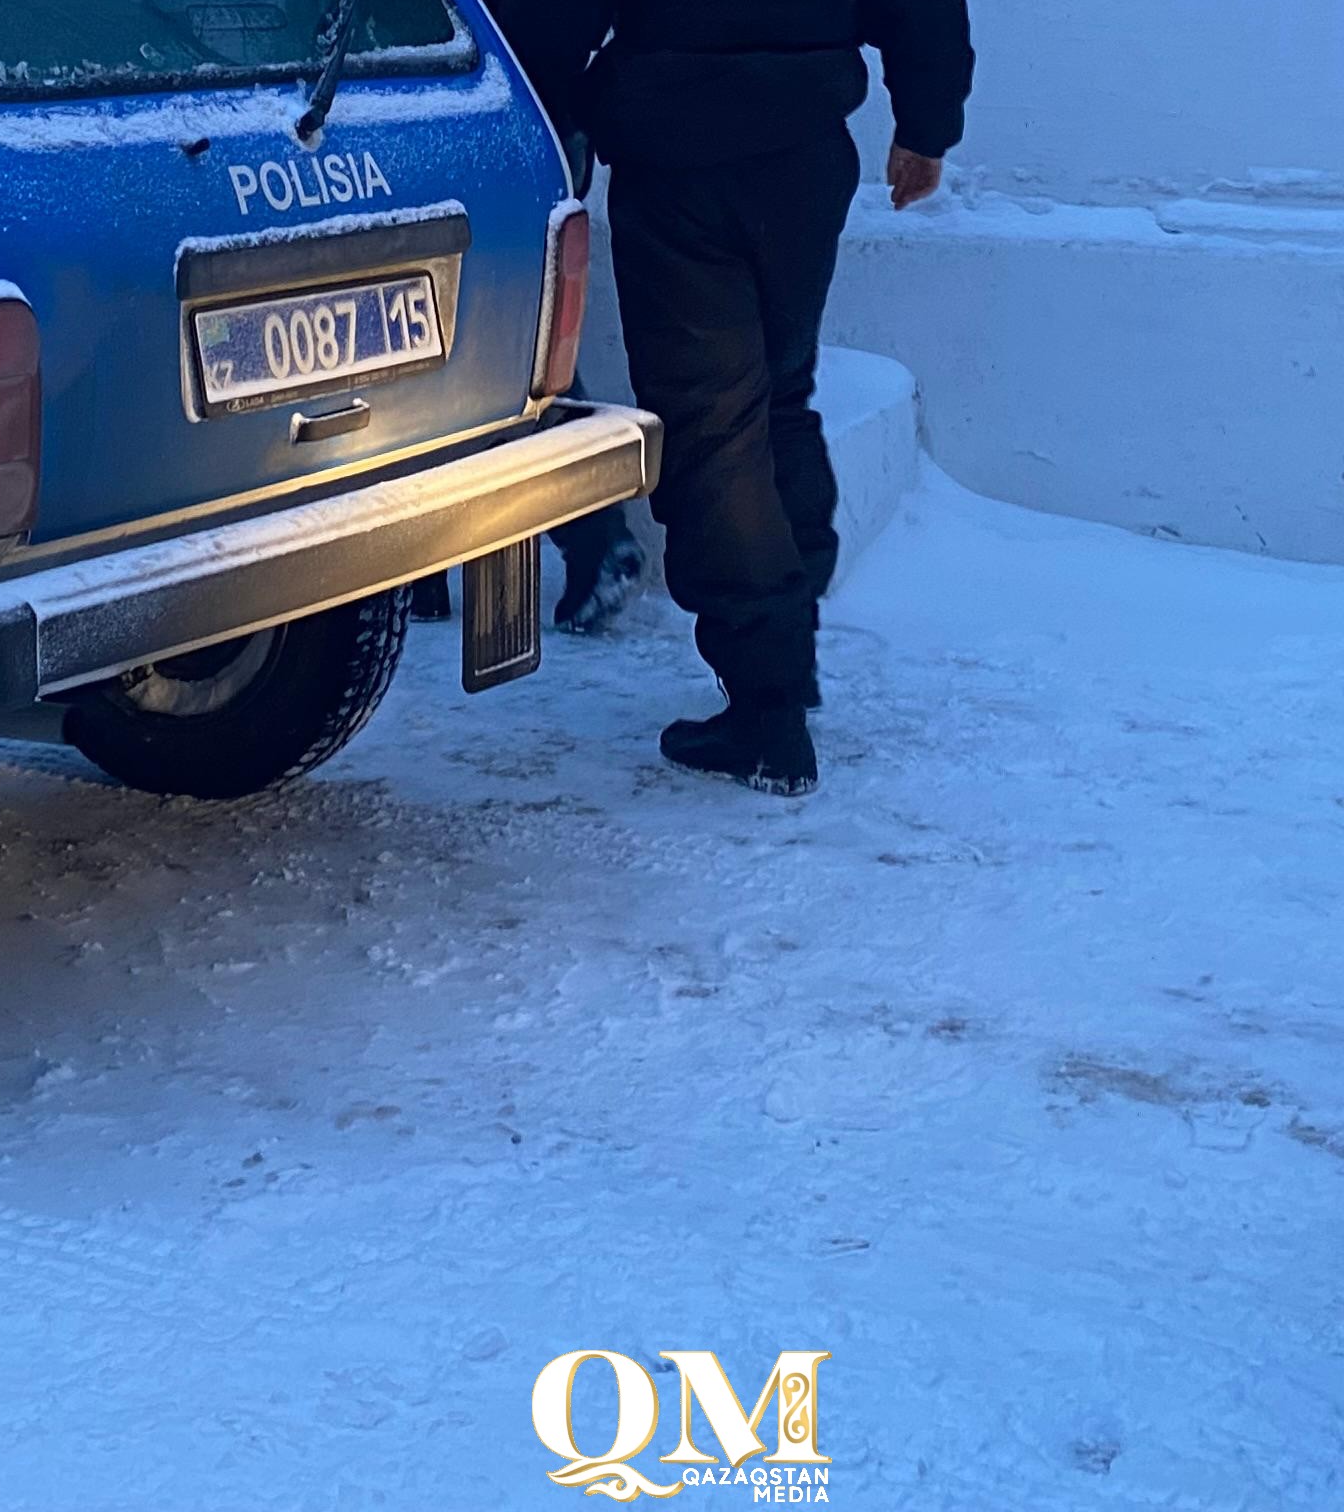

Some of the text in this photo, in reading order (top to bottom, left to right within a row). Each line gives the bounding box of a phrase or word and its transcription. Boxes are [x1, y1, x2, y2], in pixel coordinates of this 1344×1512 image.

[228, 151, 392, 215] POLISIA
[264, 299, 357, 378] 0087
[388, 289, 432, 352] 15
